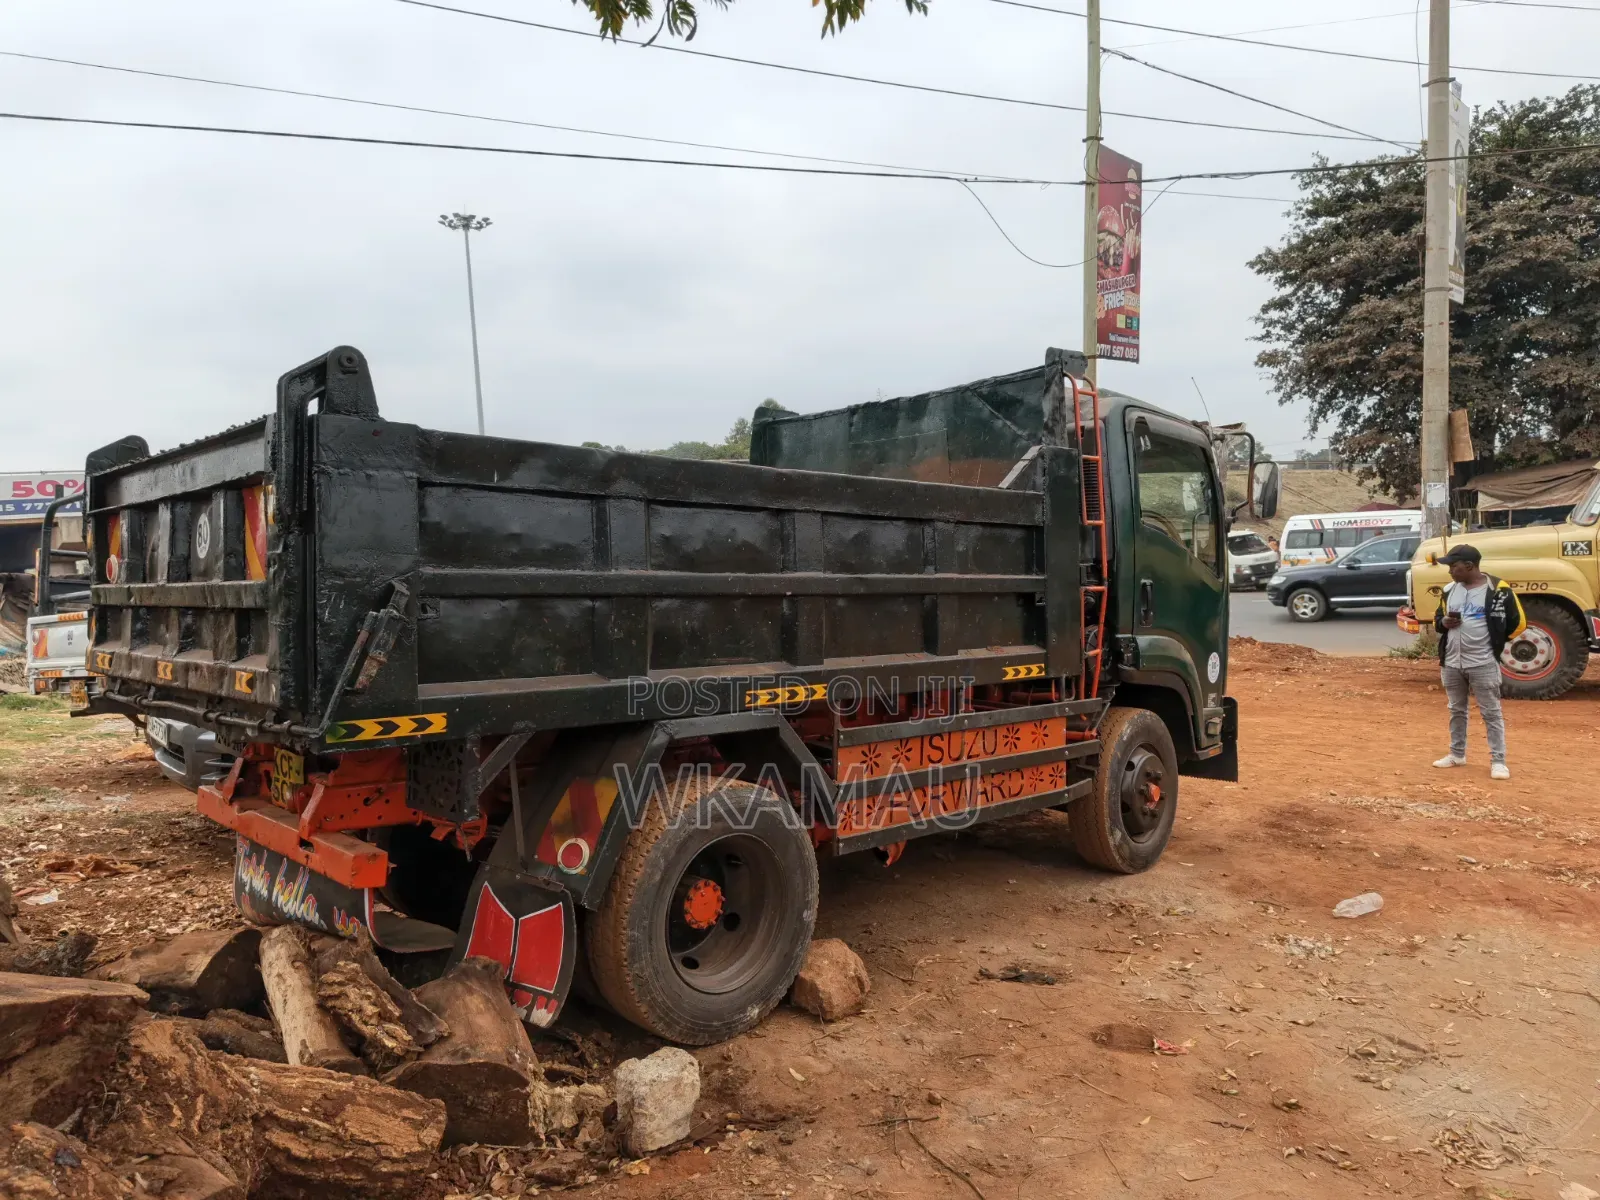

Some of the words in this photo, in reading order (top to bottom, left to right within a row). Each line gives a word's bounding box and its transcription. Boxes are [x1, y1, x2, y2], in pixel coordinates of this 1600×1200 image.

[1112, 345, 1124, 358] 567
[1125, 347, 1138, 360] 089
[1563, 541, 1588, 551] TX
[919, 729, 998, 766] ISUZU
[889, 769, 1025, 823] FORWARD
